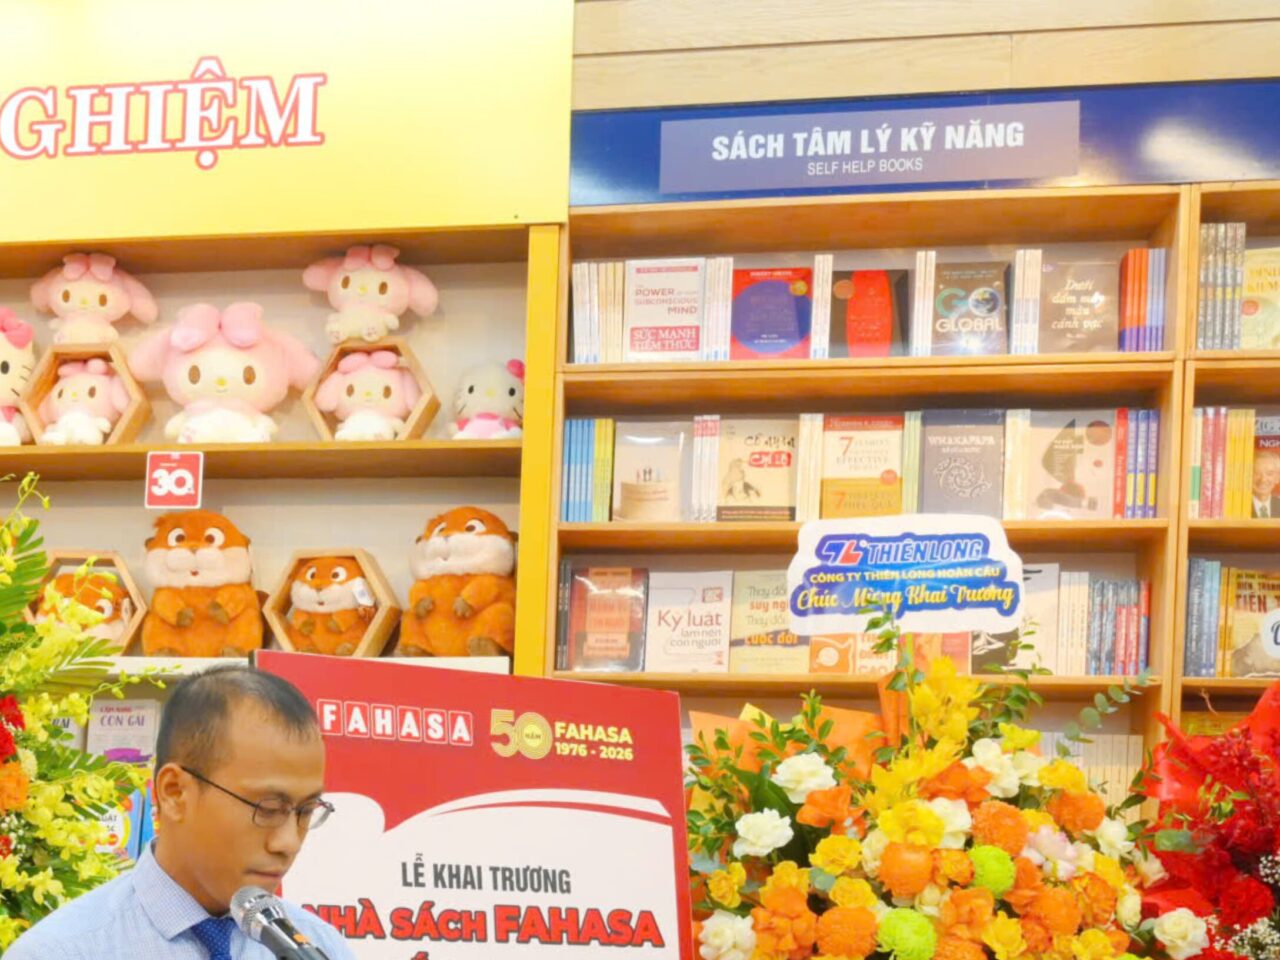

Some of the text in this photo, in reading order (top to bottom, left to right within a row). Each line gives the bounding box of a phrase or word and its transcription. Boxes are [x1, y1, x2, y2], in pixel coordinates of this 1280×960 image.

[712, 118, 1025, 161] SÁCH TÂM LÝ KỸ NĂNG
[807, 158, 923, 176] SELF HELP BOOKS
[810, 572, 845, 584] CÔNG
[847, 572, 862, 581] TY
[797, 585, 839, 611] Chúc
[904, 583, 948, 606] Khai
[322, 702, 472, 743] FAHASA
[490, 708, 553, 760] 50
[554, 720, 633, 745] FAHASA
[555, 743, 588, 758] 1976
[599, 746, 634, 761] 2026
[401, 852, 572, 894] LỄ KHAI TRƯƠNG
[390, 901, 487, 942] SÁCH
[494, 904, 665, 948] FAHASA
